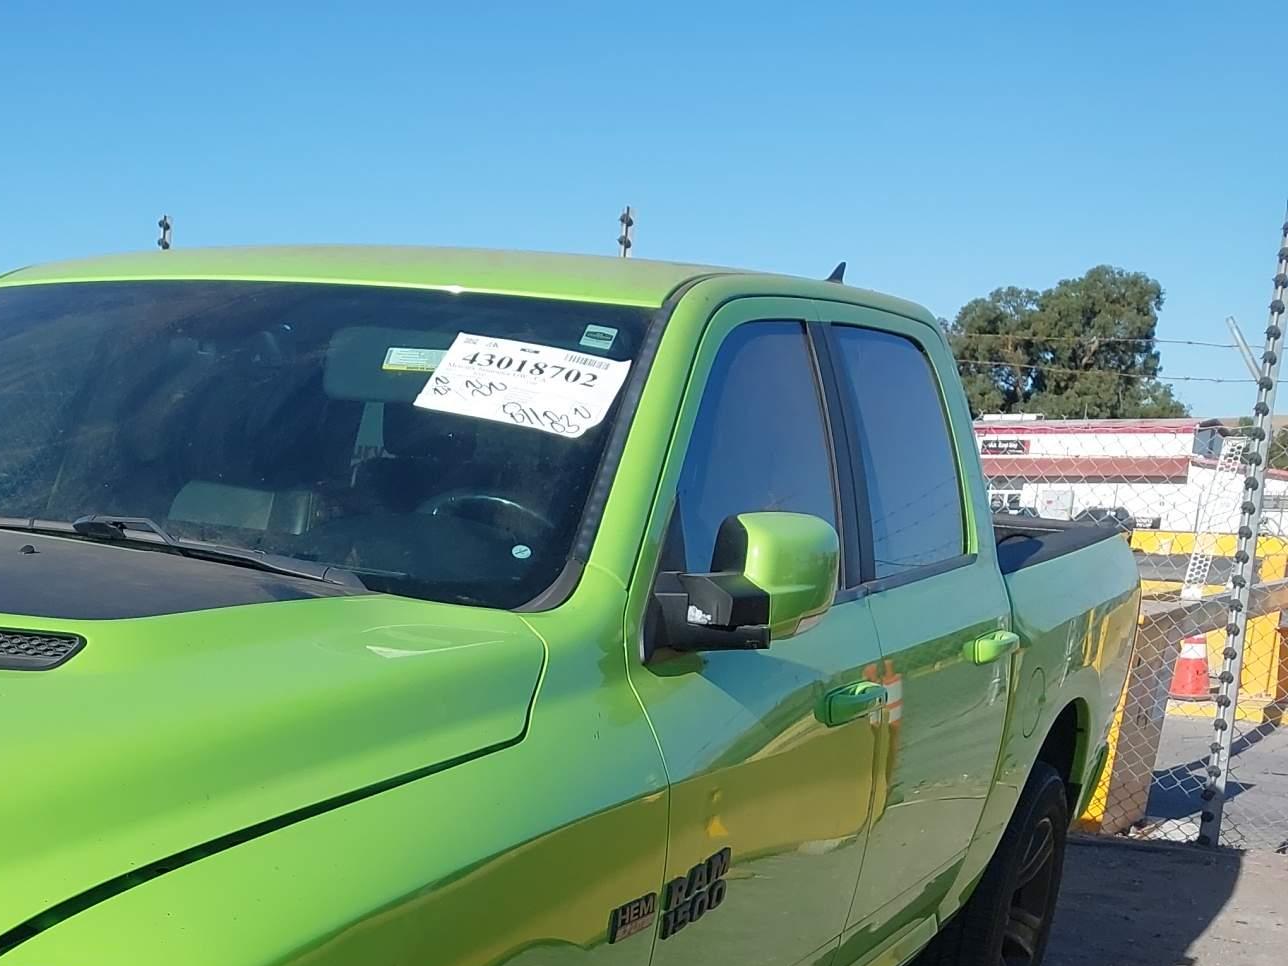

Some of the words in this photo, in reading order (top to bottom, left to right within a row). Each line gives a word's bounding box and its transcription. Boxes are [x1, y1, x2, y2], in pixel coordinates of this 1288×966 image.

[462, 351, 599, 388] 43018702
[659, 879, 727, 940] 1500
[661, 847, 731, 912] RAM
